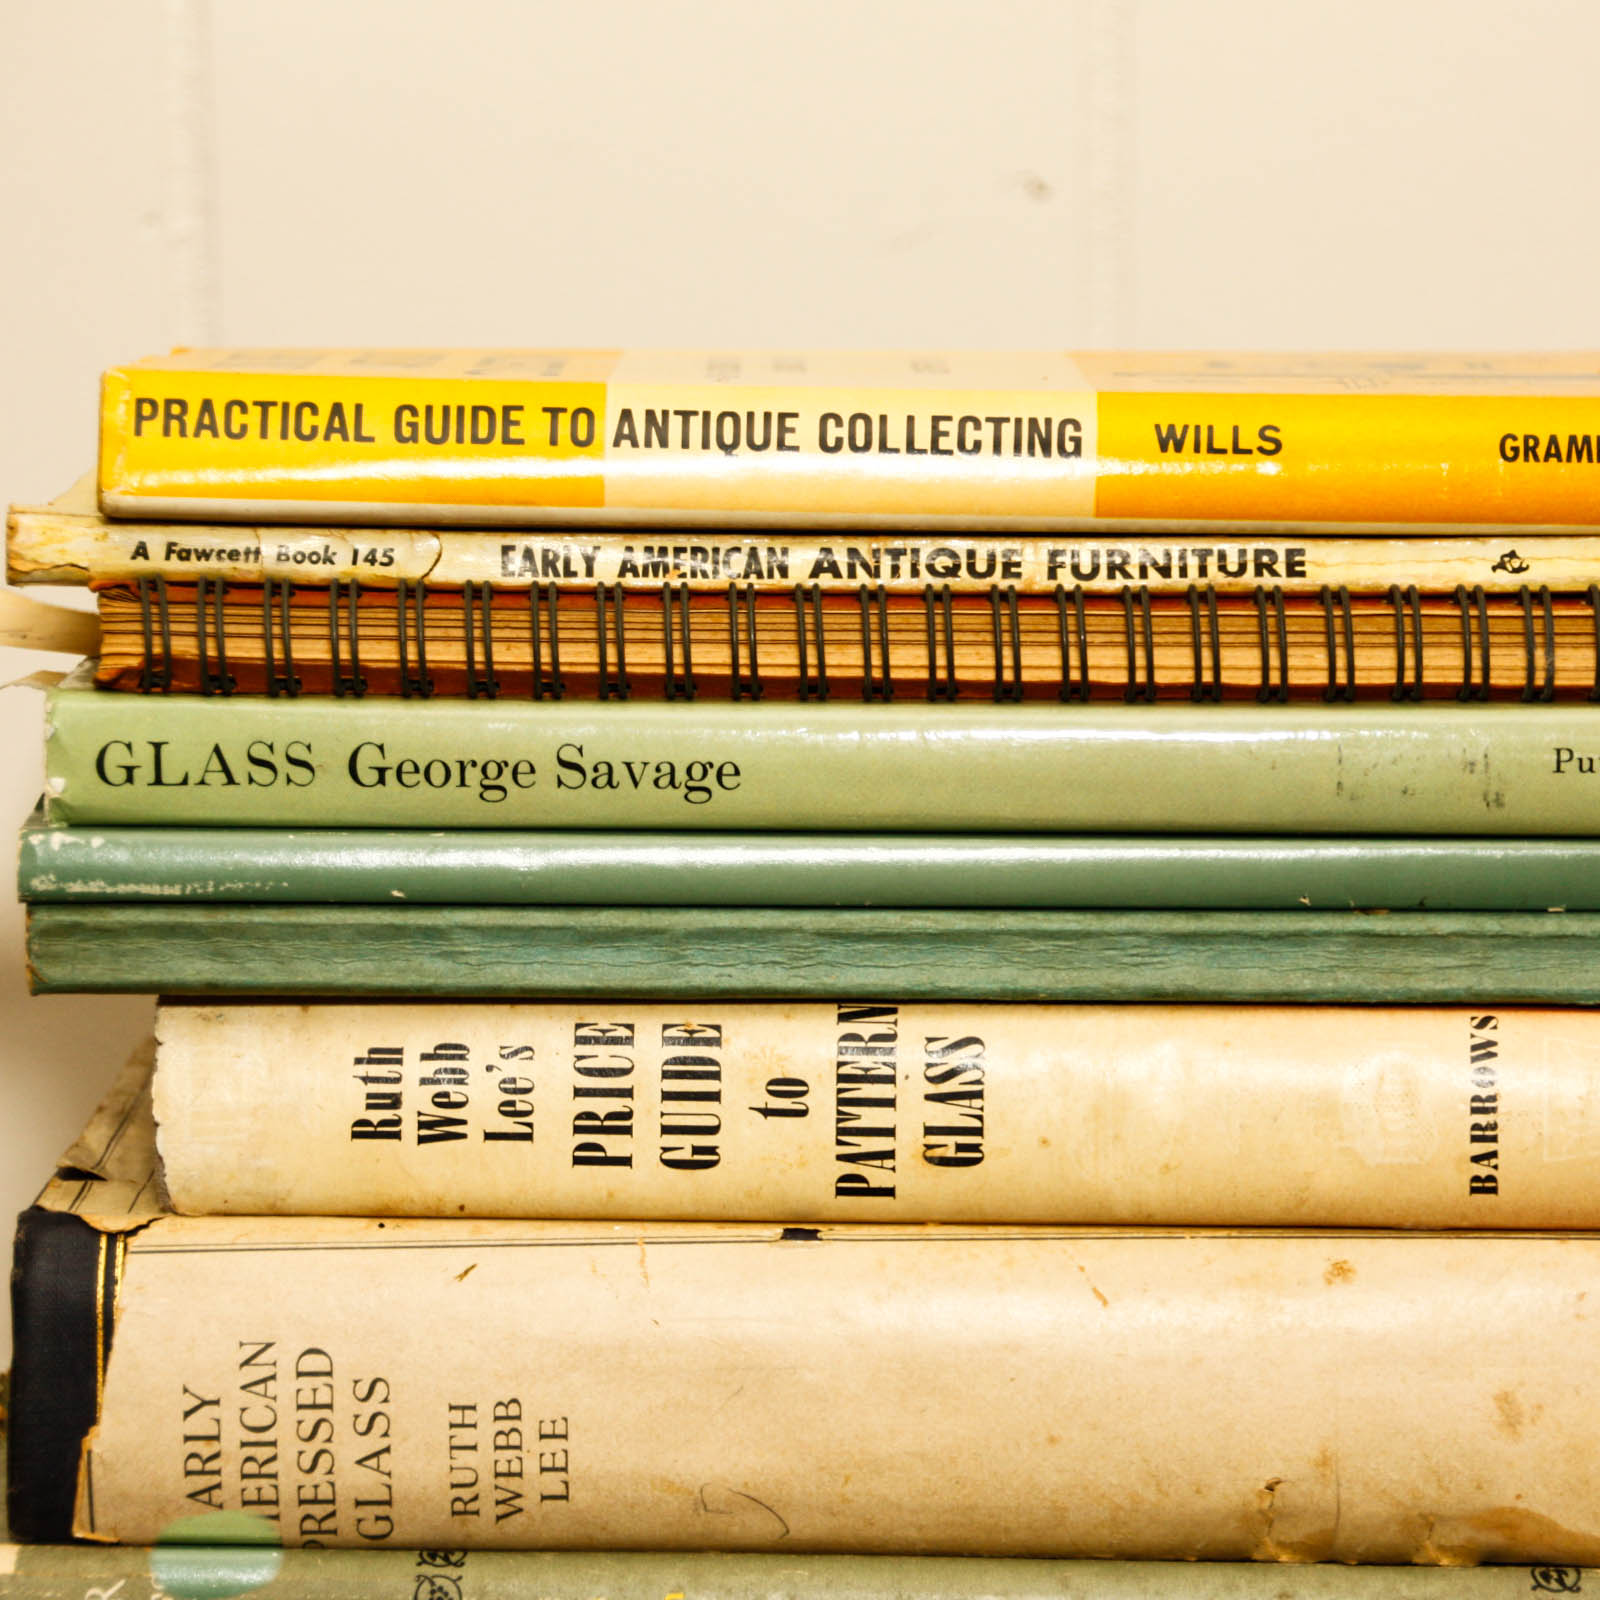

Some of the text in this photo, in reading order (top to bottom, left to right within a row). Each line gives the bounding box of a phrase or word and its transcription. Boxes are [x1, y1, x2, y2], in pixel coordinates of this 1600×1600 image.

[134, 397, 1082, 459] PRACTICAL GUIDE TO ANTIQUE COLLECTING
[1154, 423, 1283, 457] WILLS
[1499, 432, 1600, 464] GRAM
[130, 541, 395, 567] A Fawcett Book 145
[500, 544, 1307, 581] EARLY AMERICAN ANTIQUE FURNITURE
[95, 740, 741, 805] GLASS George Savage
[1552, 747, 1600, 774] Pu
[350, 1046, 404, 1142] Ruth
[416, 1042, 470, 1146] Webb
[483, 1045, 535, 1144] Lee's
[571, 1022, 635, 1169] PRICE
[659, 1023, 722, 1171] GUIDE
[748, 1077, 810, 1120] to
[834, 1004, 899, 1200] PATTERN
[922, 1036, 986, 1168] GLASS
[1469, 1015, 1499, 1196] BARROWS
[182, 1384, 224, 1510] ARLY
[352, 1376, 394, 1541] GLASS
[448, 1402, 482, 1518] RUTH
[492, 1397, 524, 1526] WEBB
[538, 1415, 570, 1504] LEE
